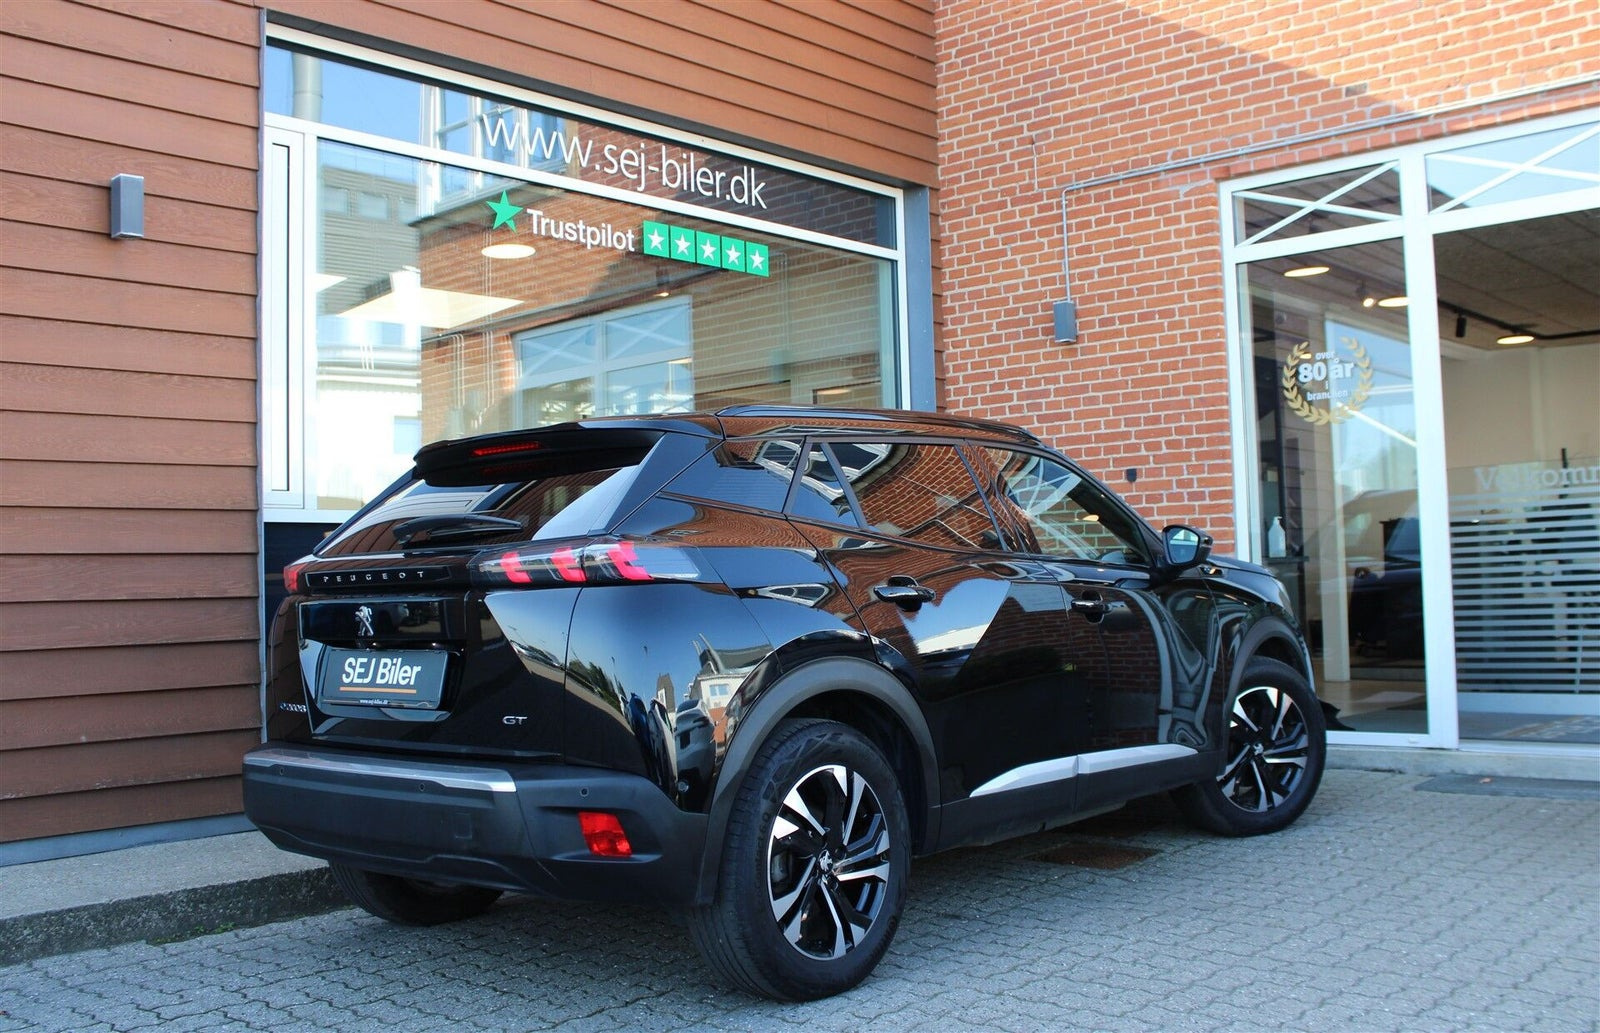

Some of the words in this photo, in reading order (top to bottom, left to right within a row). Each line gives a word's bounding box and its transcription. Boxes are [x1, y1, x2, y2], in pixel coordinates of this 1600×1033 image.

[482, 113, 767, 209] www.sej-biler.dk
[527, 208, 635, 251] Trustpilot
[1315, 351, 1335, 360] over
[1298, 361, 1327, 383] 80
[1329, 358, 1354, 379] år
[323, 571, 424, 583] PEUGEOT
[342, 657, 376, 684] SEJ
[376, 657, 422, 686] Biler
[502, 715, 528, 726] GT
